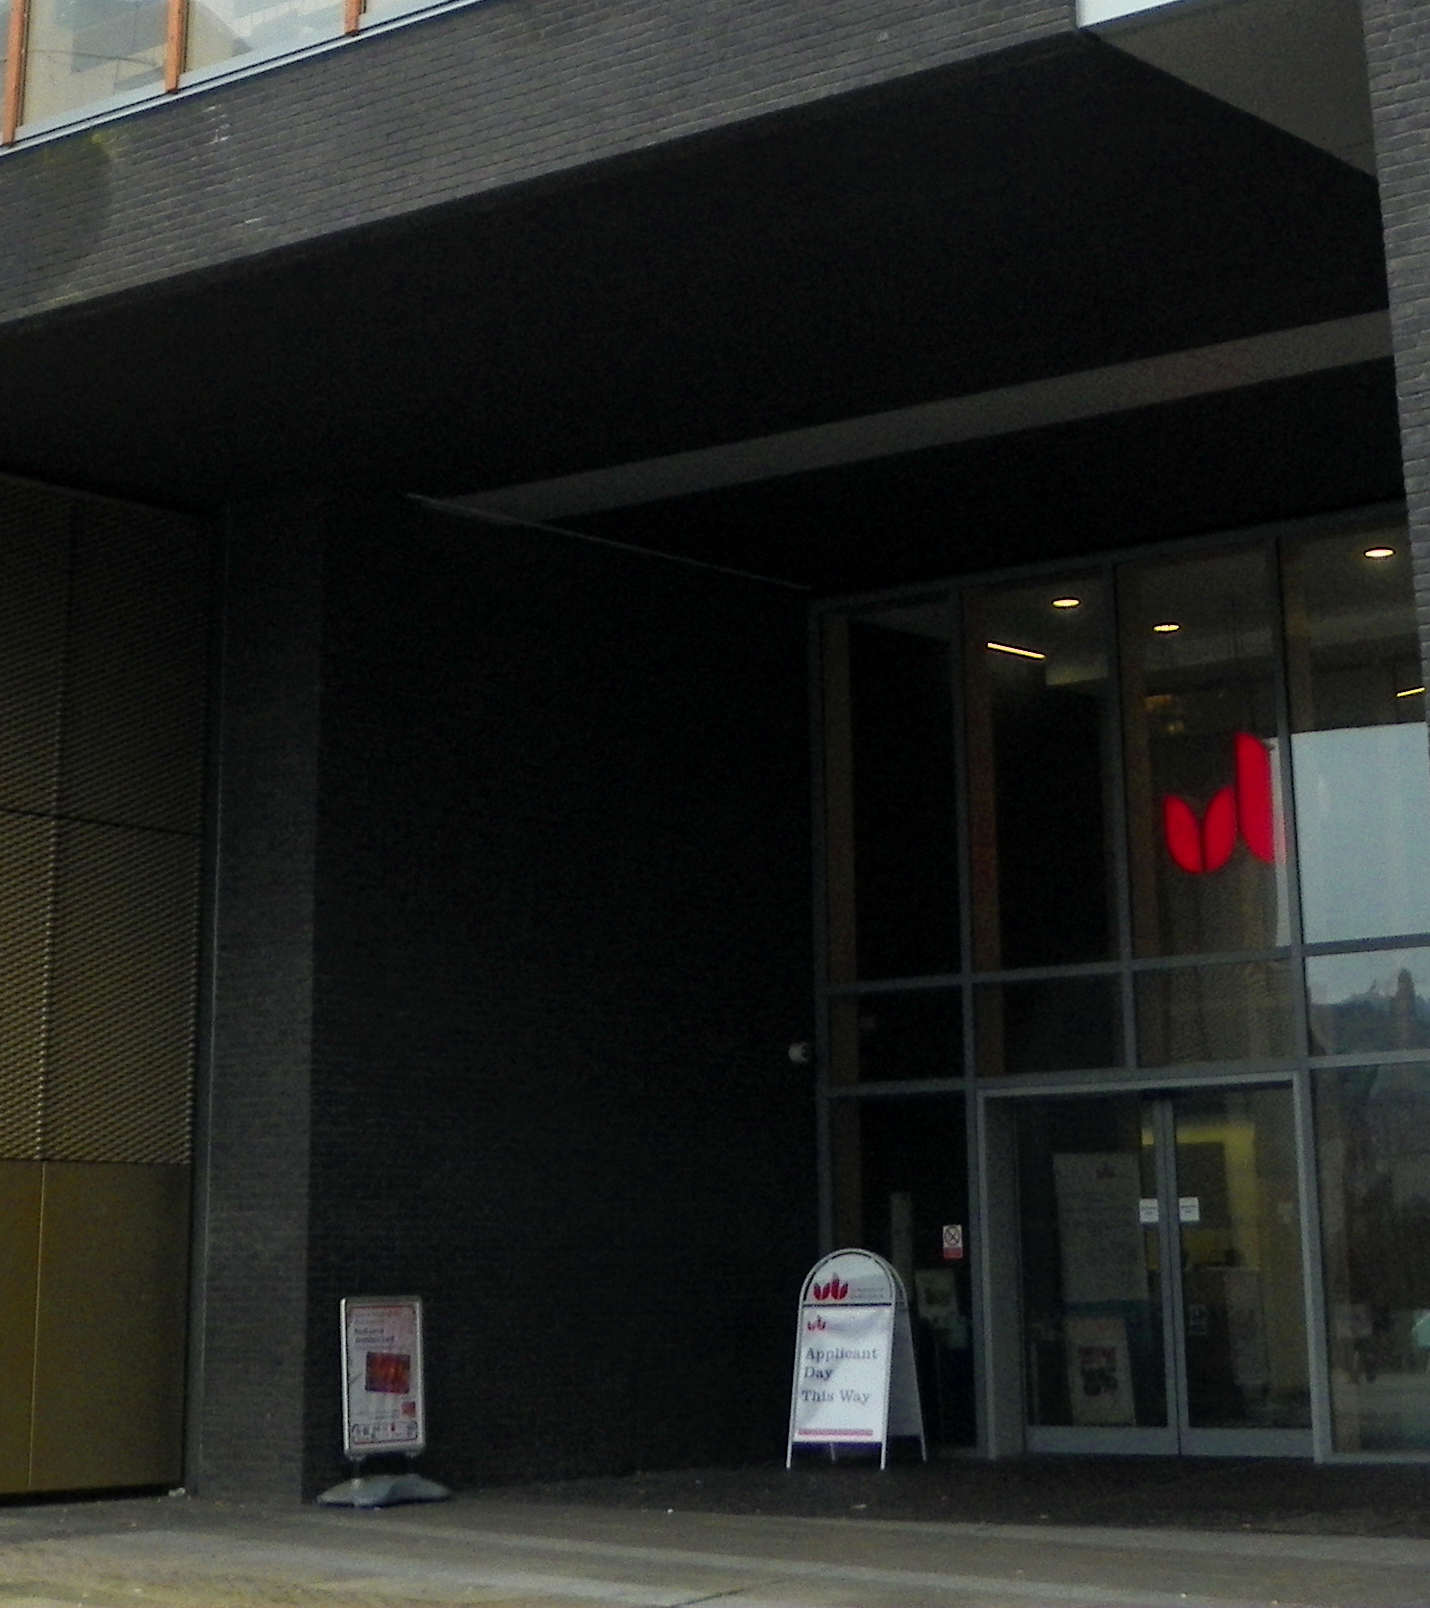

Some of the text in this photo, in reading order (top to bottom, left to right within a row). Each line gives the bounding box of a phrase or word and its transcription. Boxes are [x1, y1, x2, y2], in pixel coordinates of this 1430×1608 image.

[803, 1346, 879, 1364] Applicant
[803, 1367, 834, 1383] Day
[801, 1389, 870, 1405] This Way
